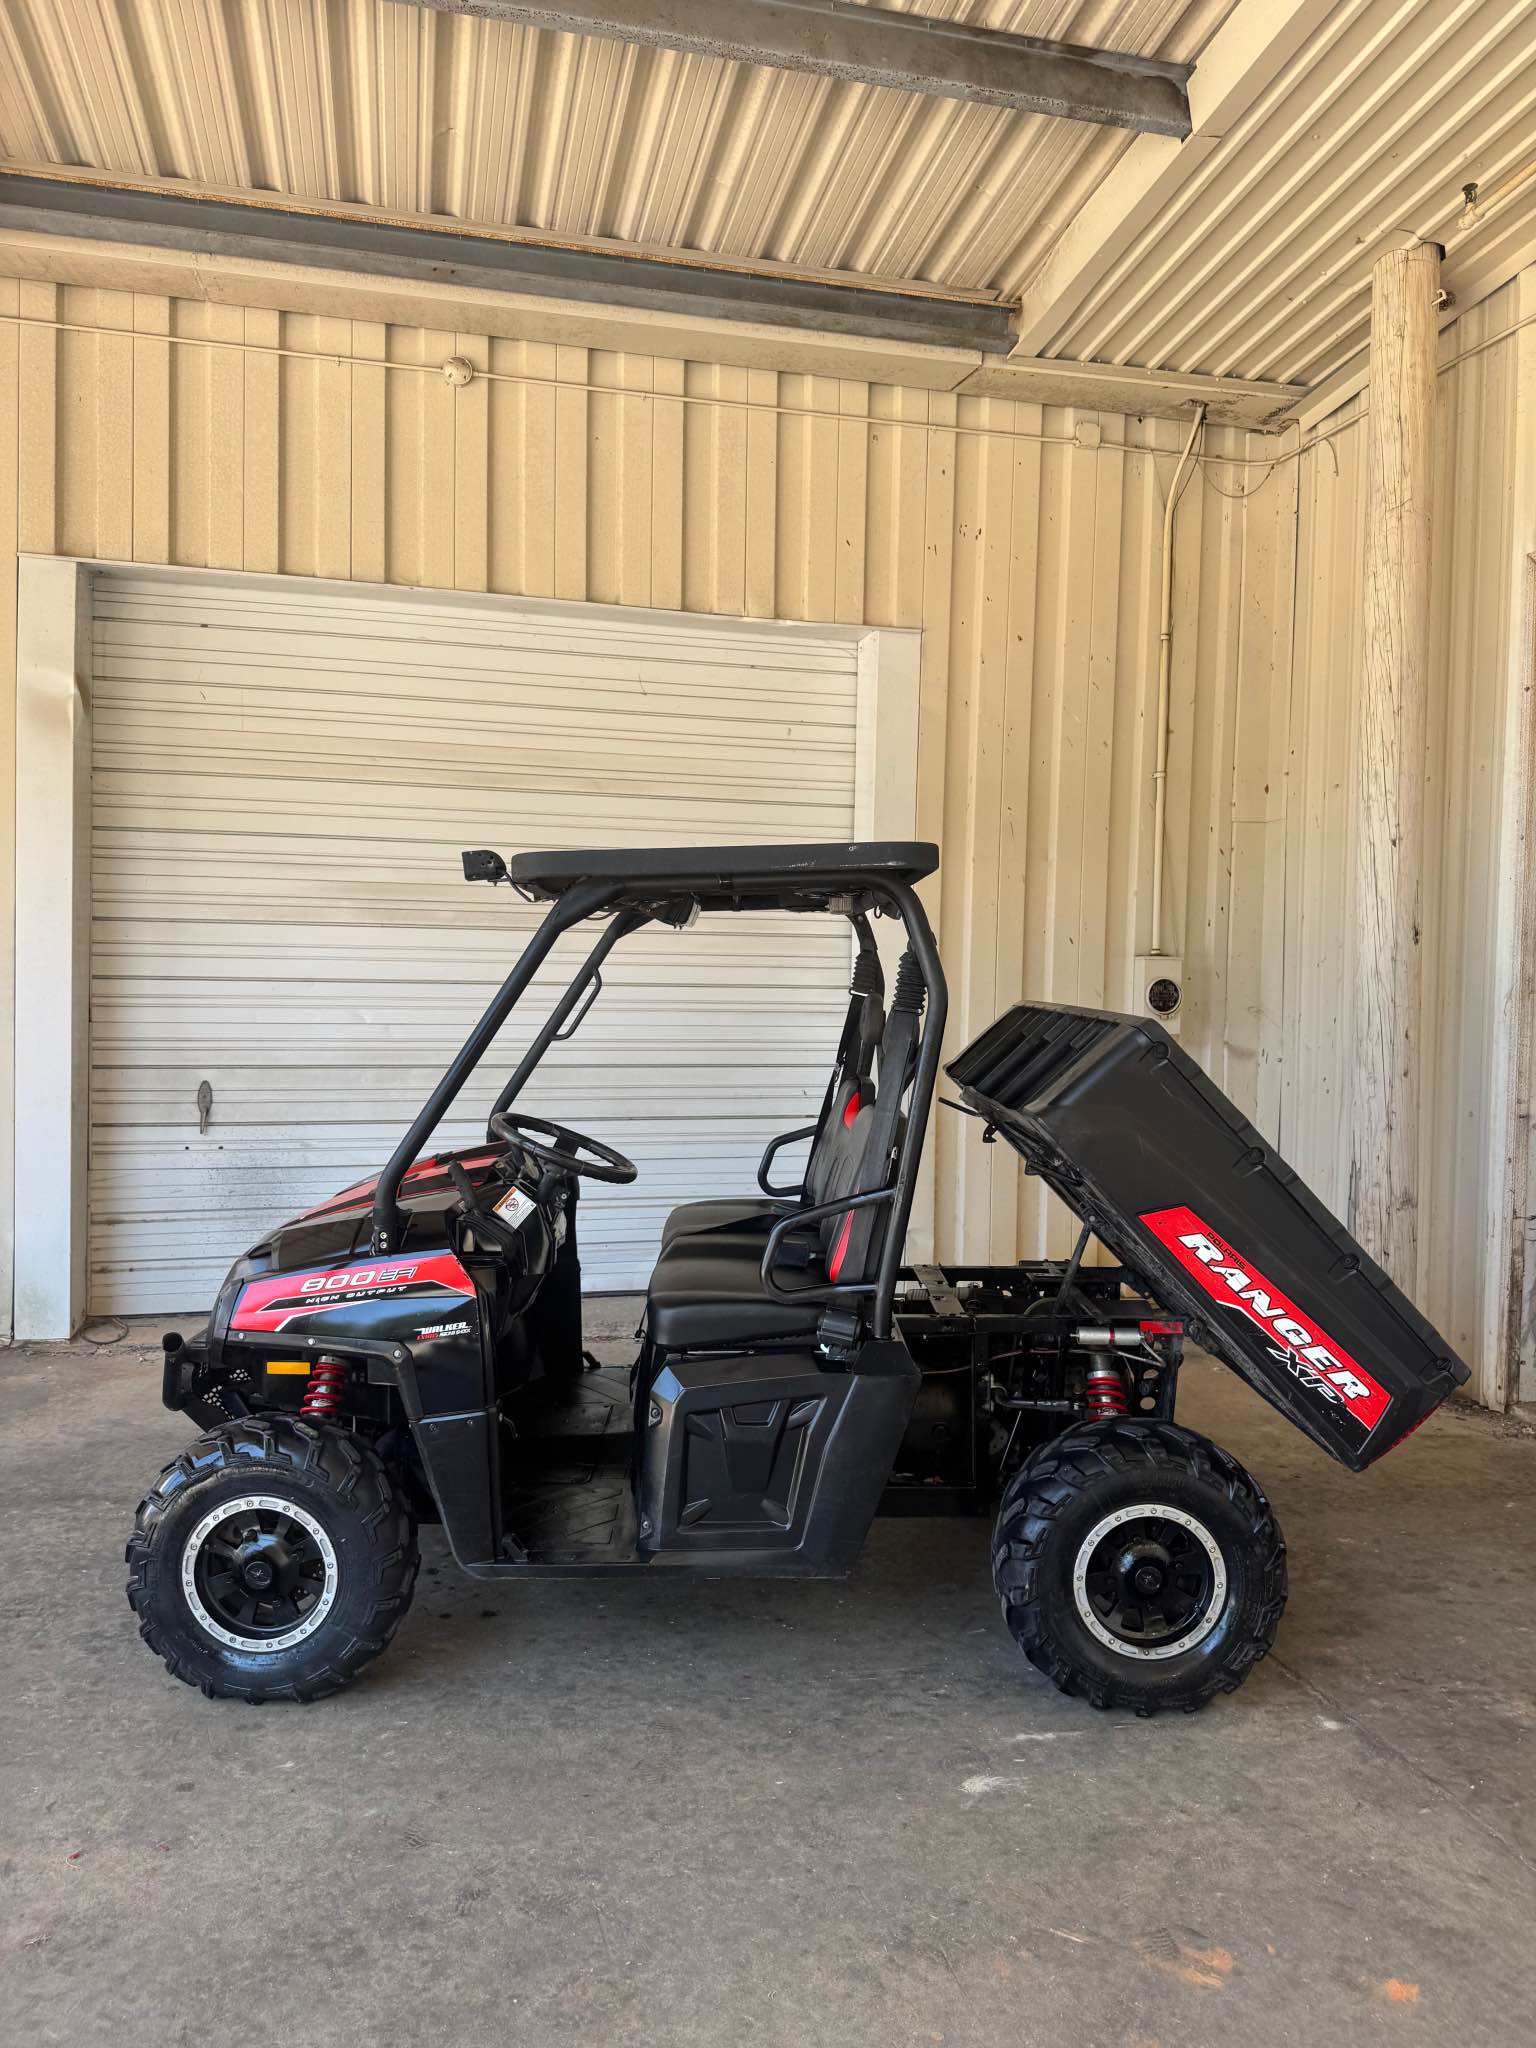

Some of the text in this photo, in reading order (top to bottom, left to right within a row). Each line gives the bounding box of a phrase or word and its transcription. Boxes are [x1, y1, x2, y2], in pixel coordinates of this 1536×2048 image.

[1206, 1232, 1246, 1269] POLARIS
[300, 1266, 418, 1293] 800 EFI
[345, 1286, 407, 1299] OUTPUT
[412, 1321, 472, 1335] WALKER
[1177, 1233, 1371, 1400] RANGER
[1266, 1346, 1344, 1404] XP
